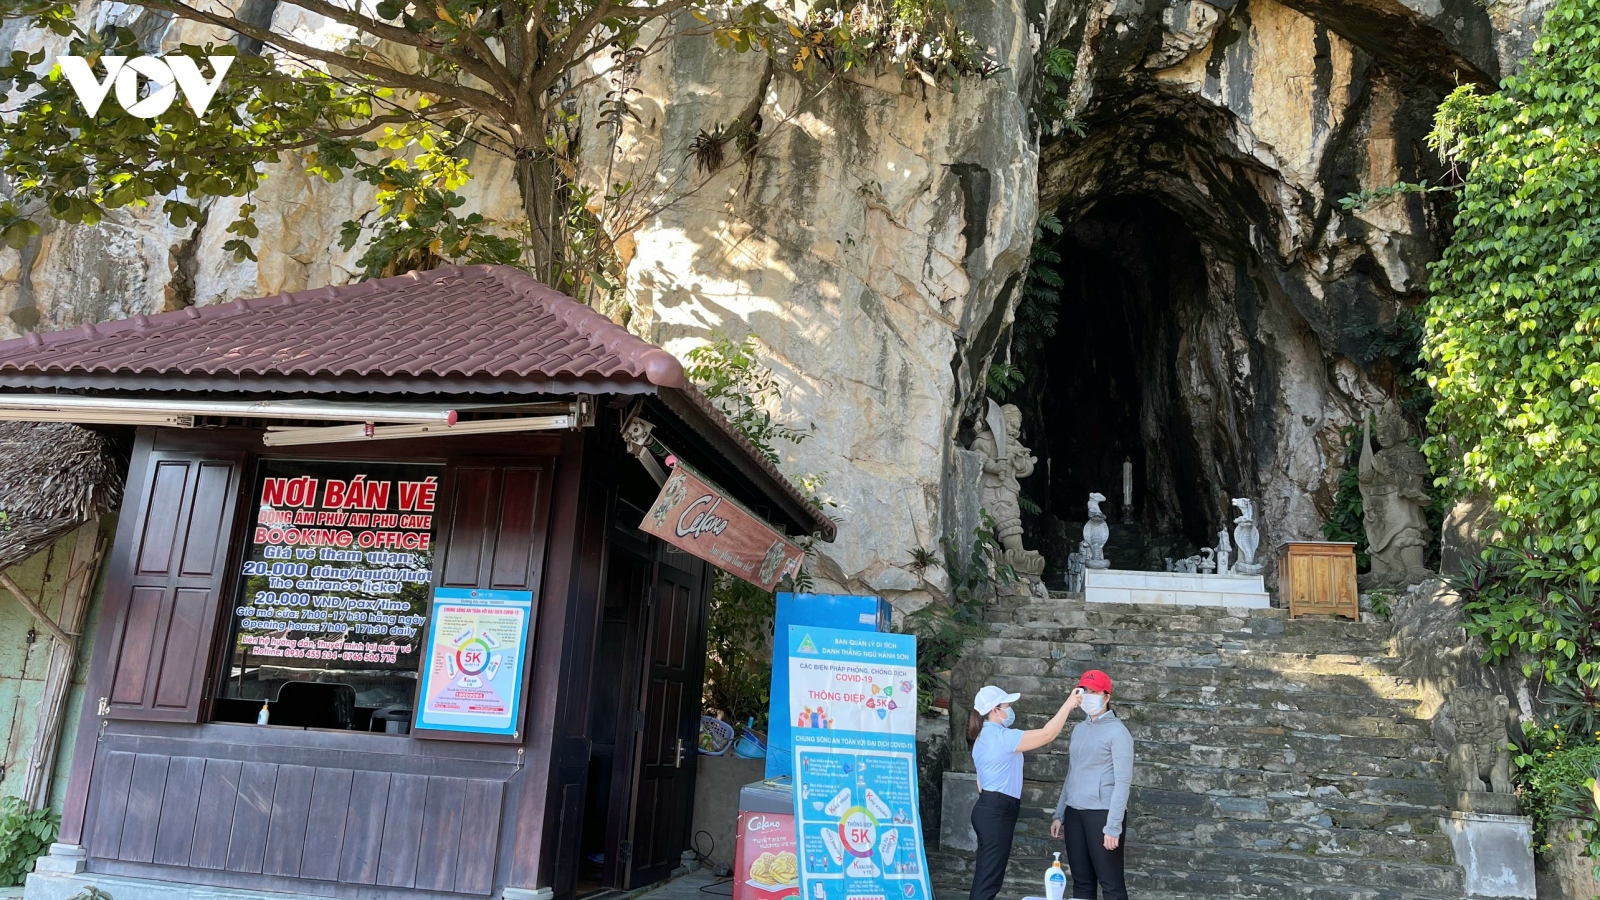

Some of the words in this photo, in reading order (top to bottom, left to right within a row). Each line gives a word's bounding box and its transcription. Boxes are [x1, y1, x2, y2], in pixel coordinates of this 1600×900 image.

[260, 475, 318, 507] NƠI
[322, 474, 391, 510] BÁN
[398, 476, 438, 511] VÉ
[293, 508, 316, 525] ÂM
[348, 513, 369, 527] AM
[371, 513, 399, 528] PHU
[399, 514, 432, 529] CAVE
[675, 494, 729, 539] Celano
[254, 527, 353, 548] BOOKING
[358, 530, 431, 549] OFFICE
[264, 545, 293, 559] Giá
[296, 546, 316, 560] vé
[320, 547, 362, 562] tham
[367, 551, 414, 564] quan:
[242, 561, 307, 577] 20.000
[269, 577, 292, 589] The
[297, 579, 358, 592] entrance
[362, 581, 402, 594] ticket
[255, 592, 309, 607] 20.000
[312, 596, 411, 612] VND/pax/time
[300, 608, 327, 619] 7h00
[398, 614, 426, 627] ngày
[241, 618, 286, 633] Opening
[287, 620, 320, 632] hours:
[320, 622, 347, 633] 7h00
[389, 625, 417, 638] daily
[241, 635, 258, 645] Liên
[343, 642, 365, 651] minh
[252, 646, 283, 656] Hotline:
[284, 648, 304, 657] 0936
[305, 649, 321, 659] 455
[321, 650, 337, 659] 234
[343, 651, 363, 661] 0766
[363, 652, 379, 662] 506
[380, 653, 397, 663] 715
[464, 652, 482, 663] 5K
[829, 664, 845, 672] PHÁP
[893, 670, 907, 678] DỊCH
[835, 673, 873, 683] COVID-19
[808, 690, 841, 701] THÔNG
[843, 693, 866, 704] ĐIỆP
[876, 699, 887, 708] 5K
[795, 735, 815, 743] CHUNG
[747, 815, 780, 831] Celano
[851, 828, 871, 844] 5K
